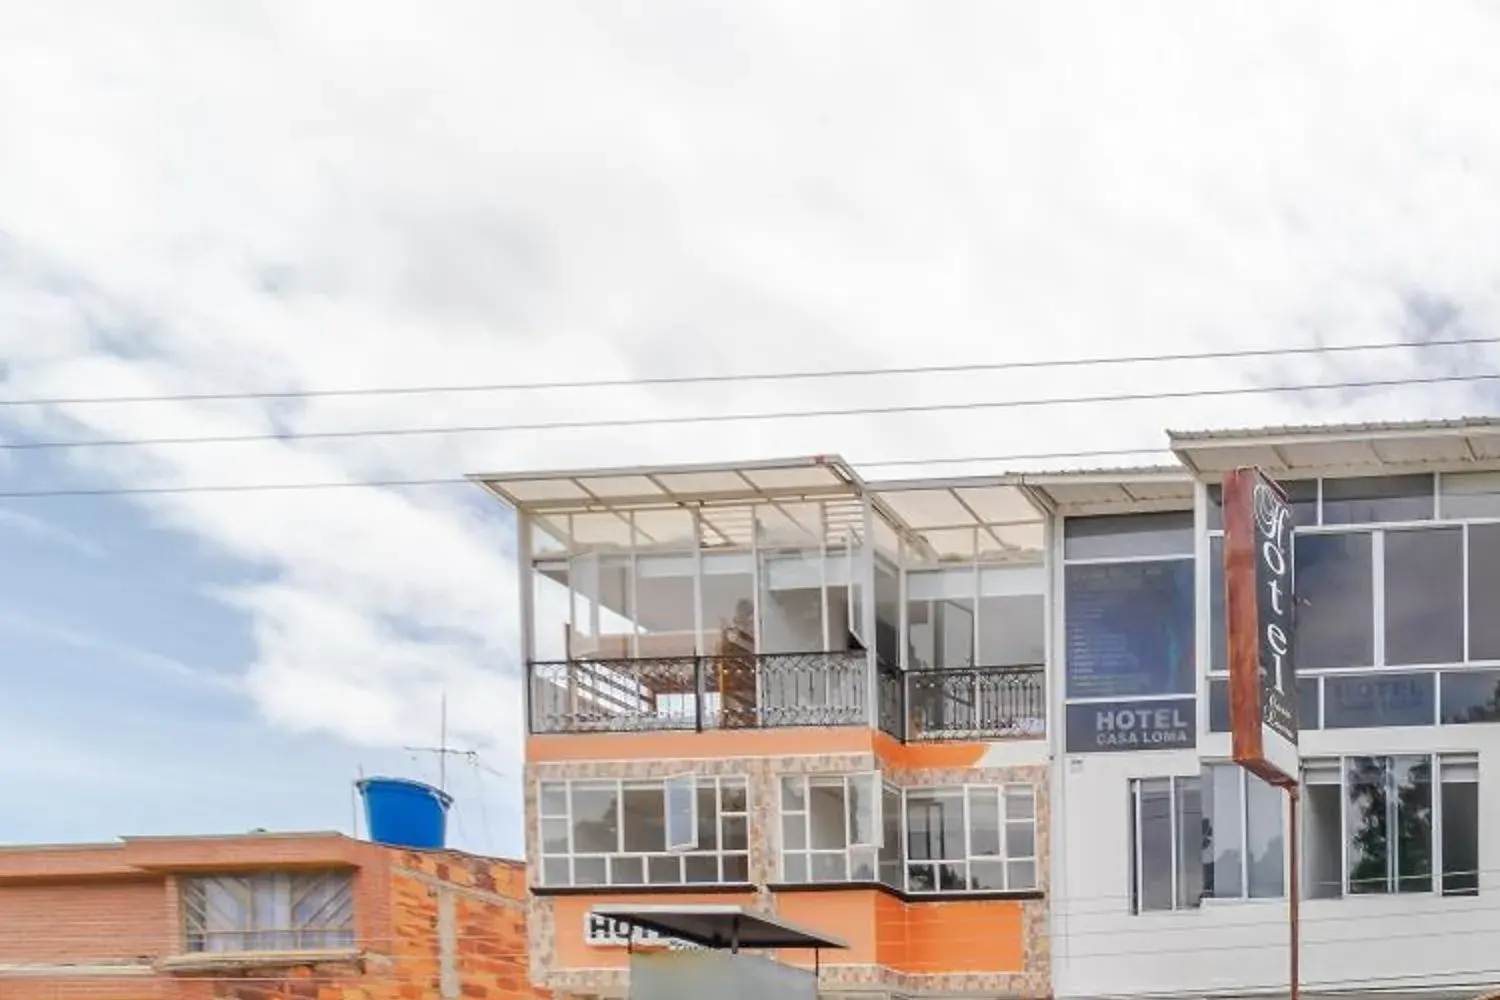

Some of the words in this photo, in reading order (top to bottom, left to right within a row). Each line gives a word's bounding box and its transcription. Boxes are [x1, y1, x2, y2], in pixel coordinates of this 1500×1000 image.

[1253, 484, 1290, 696] Hotel
[1096, 709, 1189, 731] HOTEL
[1096, 731, 1139, 745] CASA
[1143, 730, 1188, 744] LOMA
